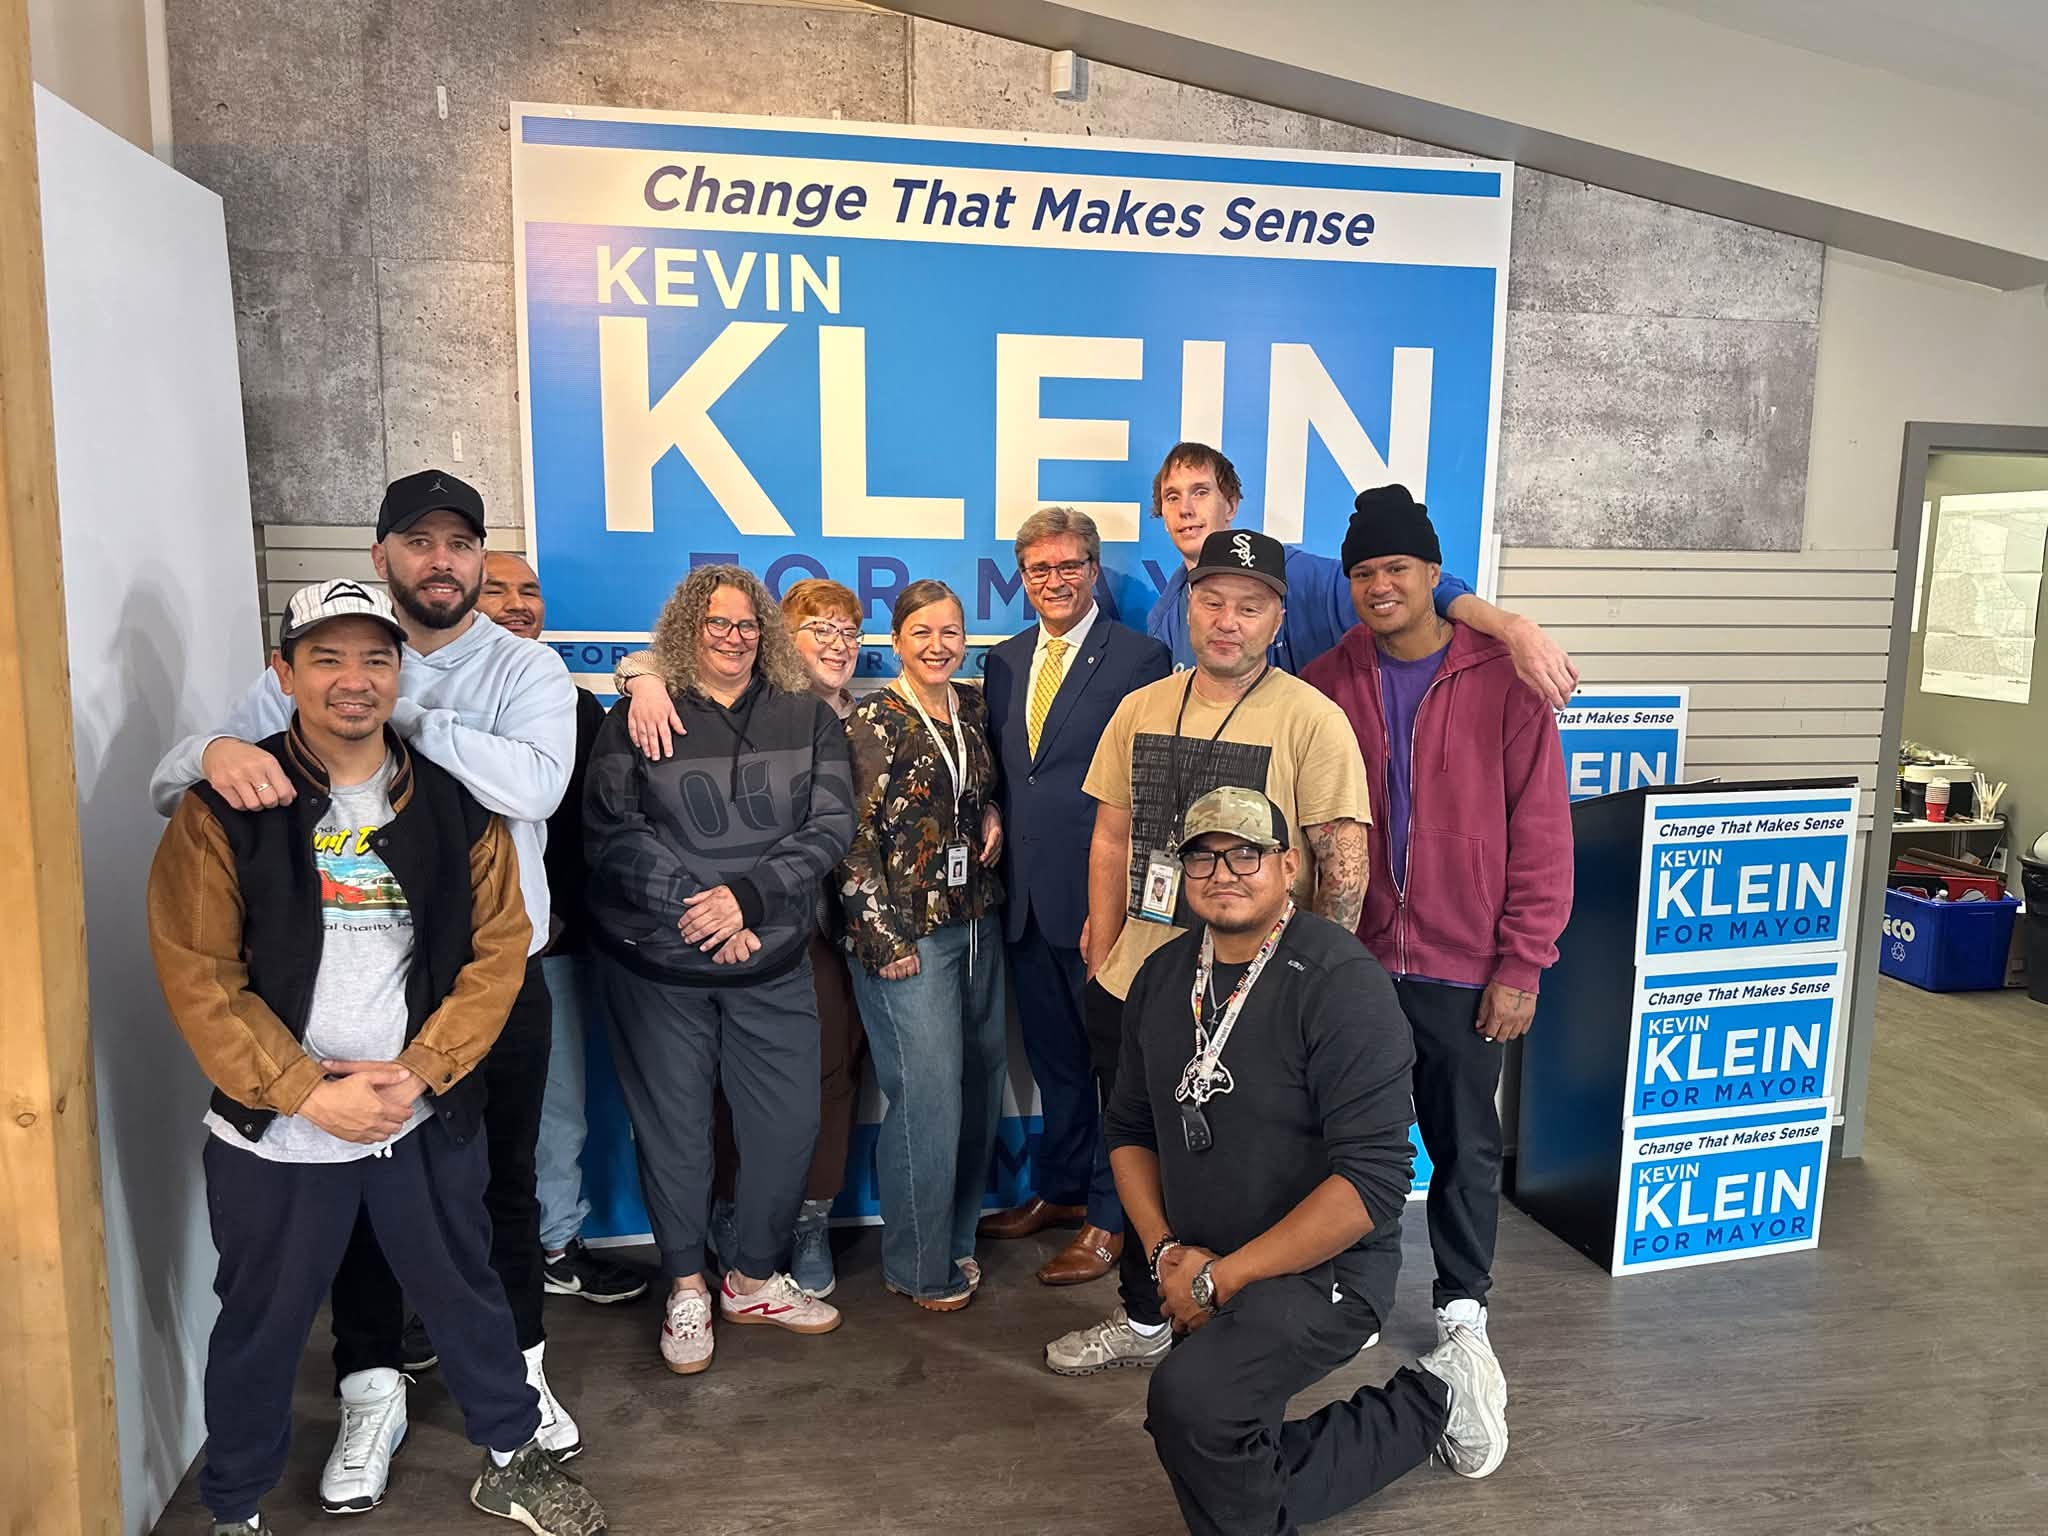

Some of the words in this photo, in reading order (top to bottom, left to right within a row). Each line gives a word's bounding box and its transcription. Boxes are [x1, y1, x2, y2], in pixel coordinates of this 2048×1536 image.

[644, 165, 867, 227] Change
[893, 178, 1016, 228] That
[1032, 187, 1205, 238] Makes
[1219, 197, 1375, 246] Sense
[596, 245, 840, 314] KEVIN
[598, 316, 1434, 543] KLEIN
[1585, 712, 1629, 724] Makes
[1633, 712, 1674, 723] Sense
[1570, 752, 1667, 795] EIN
[1659, 822, 1715, 838] Change
[1721, 820, 1751, 834] That
[1755, 818, 1800, 833] Makes
[1803, 816, 1844, 830] Sense
[1660, 848, 1723, 868] KEVIN
[1656, 861, 1836, 919] KLEIN
[1656, 923, 1713, 945] FOR
[1730, 915, 1830, 940] MAYOR
[1648, 991, 1702, 1006] Change
[1708, 987, 1739, 1001] That
[1742, 984, 1786, 999] Makes
[1789, 981, 1830, 995] Sense
[1649, 1014, 1710, 1035] KEVIN
[1644, 1023, 1821, 1085] KLEIN
[1642, 1087, 1699, 1110] FOR
[1715, 1075, 1816, 1102] MAYOR
[1638, 1139, 1692, 1156] Change
[1698, 1134, 1729, 1149] That
[1732, 1129, 1775, 1145] Makes
[1779, 1125, 1820, 1140] Sense
[1639, 1162, 1700, 1184] KEVIN
[1635, 1165, 1811, 1232] KLEIN
[1632, 1231, 1690, 1256] FOR
[1706, 1216, 1806, 1246] MAYOR
